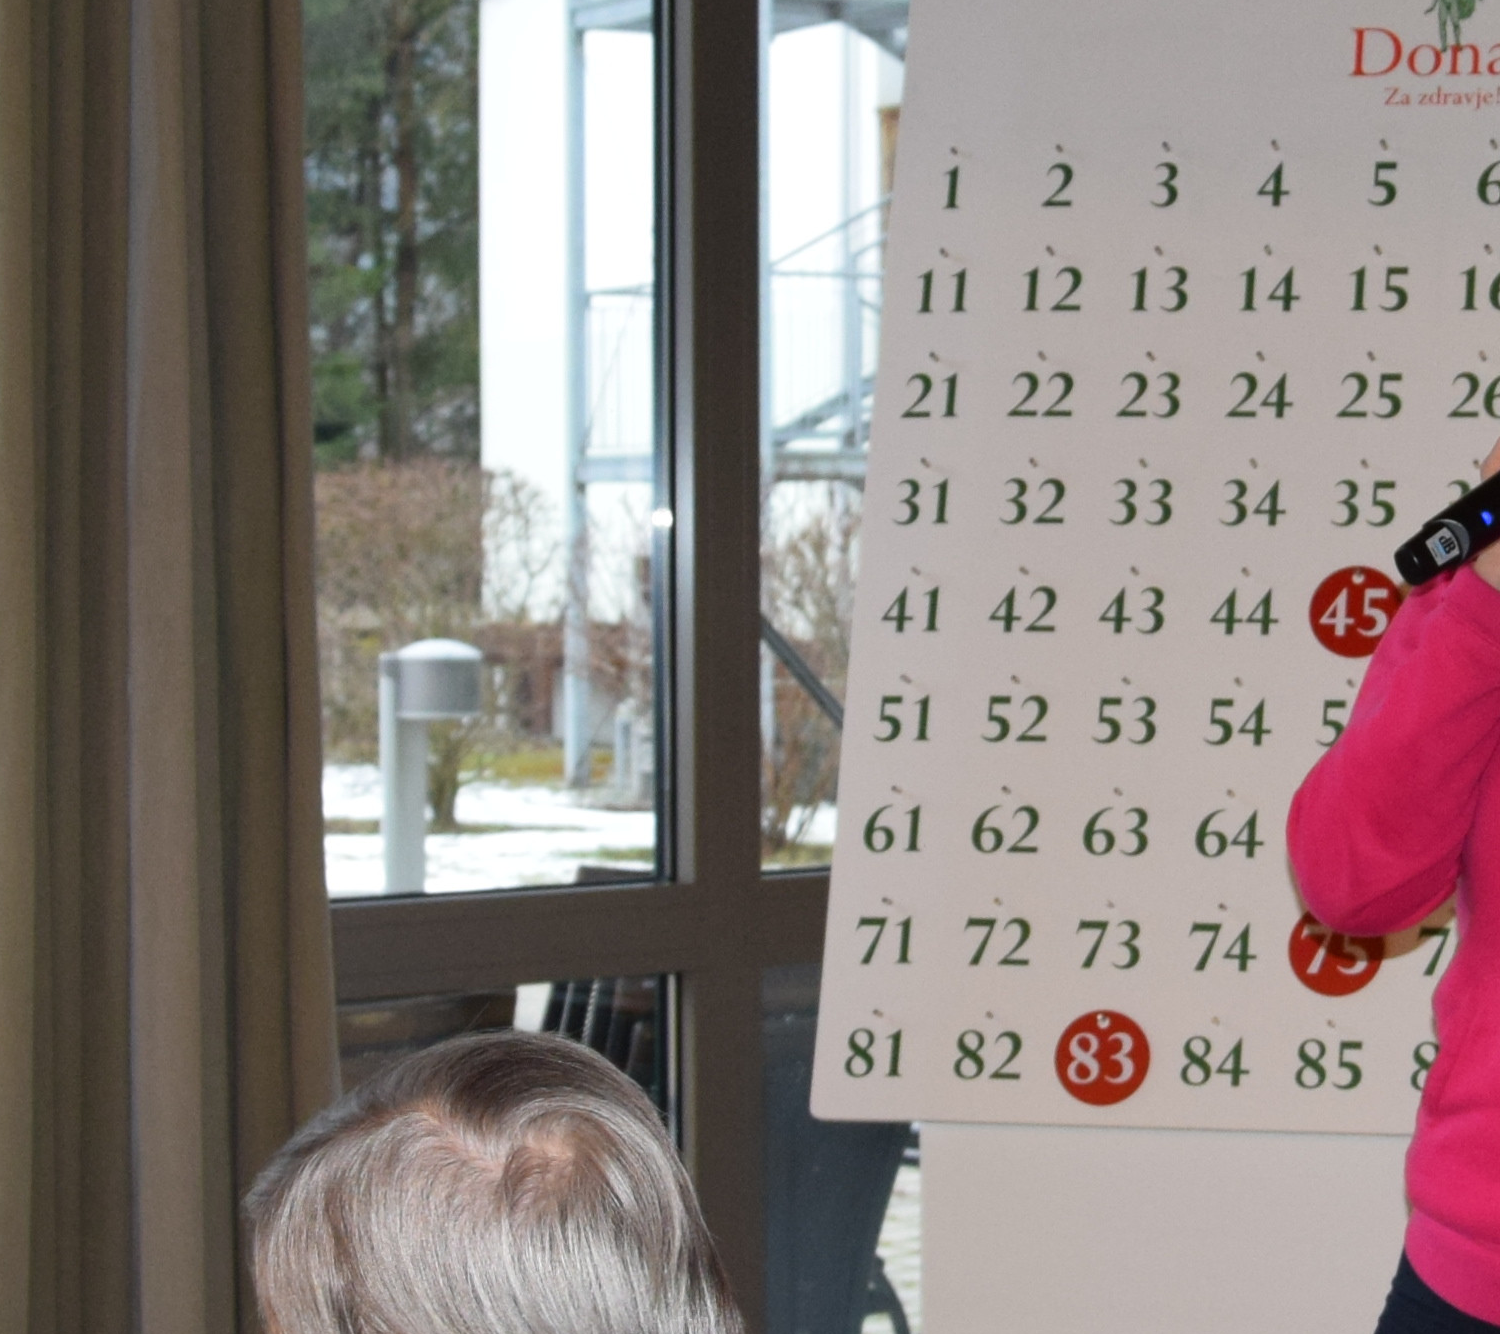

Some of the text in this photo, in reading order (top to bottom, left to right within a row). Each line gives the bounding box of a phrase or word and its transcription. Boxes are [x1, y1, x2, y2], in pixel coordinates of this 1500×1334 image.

[1384, 87, 1412, 107] Za
[944, 165, 960, 210] 1
[1041, 162, 1074, 208] 2
[1152, 161, 1179, 209] 3
[1256, 162, 1291, 208] 4
[1368, 160, 1398, 207] 5
[918, 267, 967, 314] 11
[1023, 266, 1083, 312] 12
[1132, 265, 1189, 313] 13
[1241, 266, 1301, 313] 14
[1350, 265, 1410, 313] 15
[900, 372, 958, 419] 21
[1006, 370, 1075, 418] 22
[1115, 371, 1181, 419] 23
[1225, 371, 1294, 420] 24
[1335, 371, 1403, 420] 25
[895, 478, 949, 526] 31
[1000, 477, 1066, 526] 32
[1109, 477, 1173, 526] 33
[1221, 478, 1287, 527] 34
[1332, 478, 1397, 528] 35
[881, 585, 1391, 638] 41 42 43 44 45
[874, 694, 1346, 747] 51 52 53 54 5
[862, 804, 922, 854] 61
[970, 804, 1040, 854] 62
[1082, 806, 1149, 857] 63
[1194, 809, 1265, 859] 64
[856, 915, 912, 966] 71
[964, 916, 1032, 967] 72
[1076, 919, 1141, 970] 73
[1189, 921, 1258, 973] 74
[1300, 923, 1369, 976] 75
[1418, 926, 1451, 976] 7
[843, 1027, 903, 1079] 81
[952, 1029, 1023, 1081] 82
[1066, 1031, 1136, 1086] 83
[1179, 1035, 1251, 1088] 84
[1294, 1038, 1364, 1091] 85
